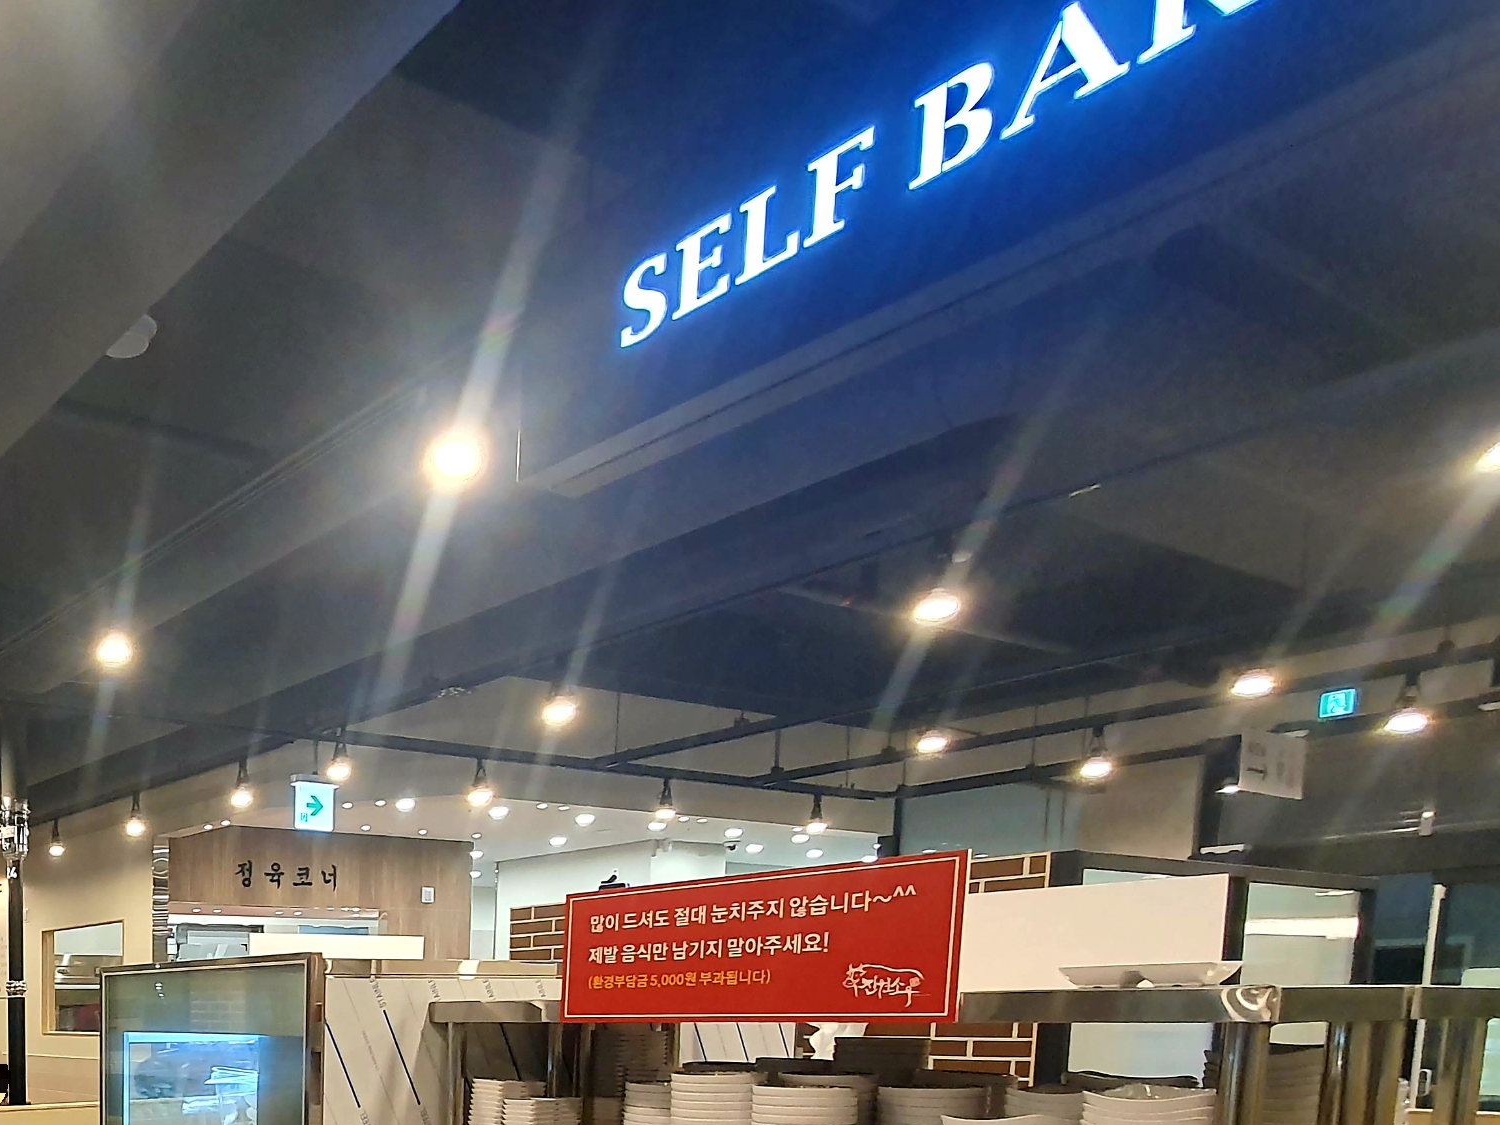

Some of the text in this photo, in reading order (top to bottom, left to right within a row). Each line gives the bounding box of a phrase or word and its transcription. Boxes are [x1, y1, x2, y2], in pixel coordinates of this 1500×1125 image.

[620, 127, 875, 348] SELF
[235, 860, 337, 892] 정육코너
[590, 913, 619, 933] 많이
[622, 909, 670, 929] 드셔도
[674, 904, 707, 927] 절대
[710, 898, 785, 924] 눈치주지
[588, 932, 830, 965] 제발 음식만 남기지 말아주세요!
[588, 967, 771, 990] (환경부담금 5,000원 부과됩니다)
